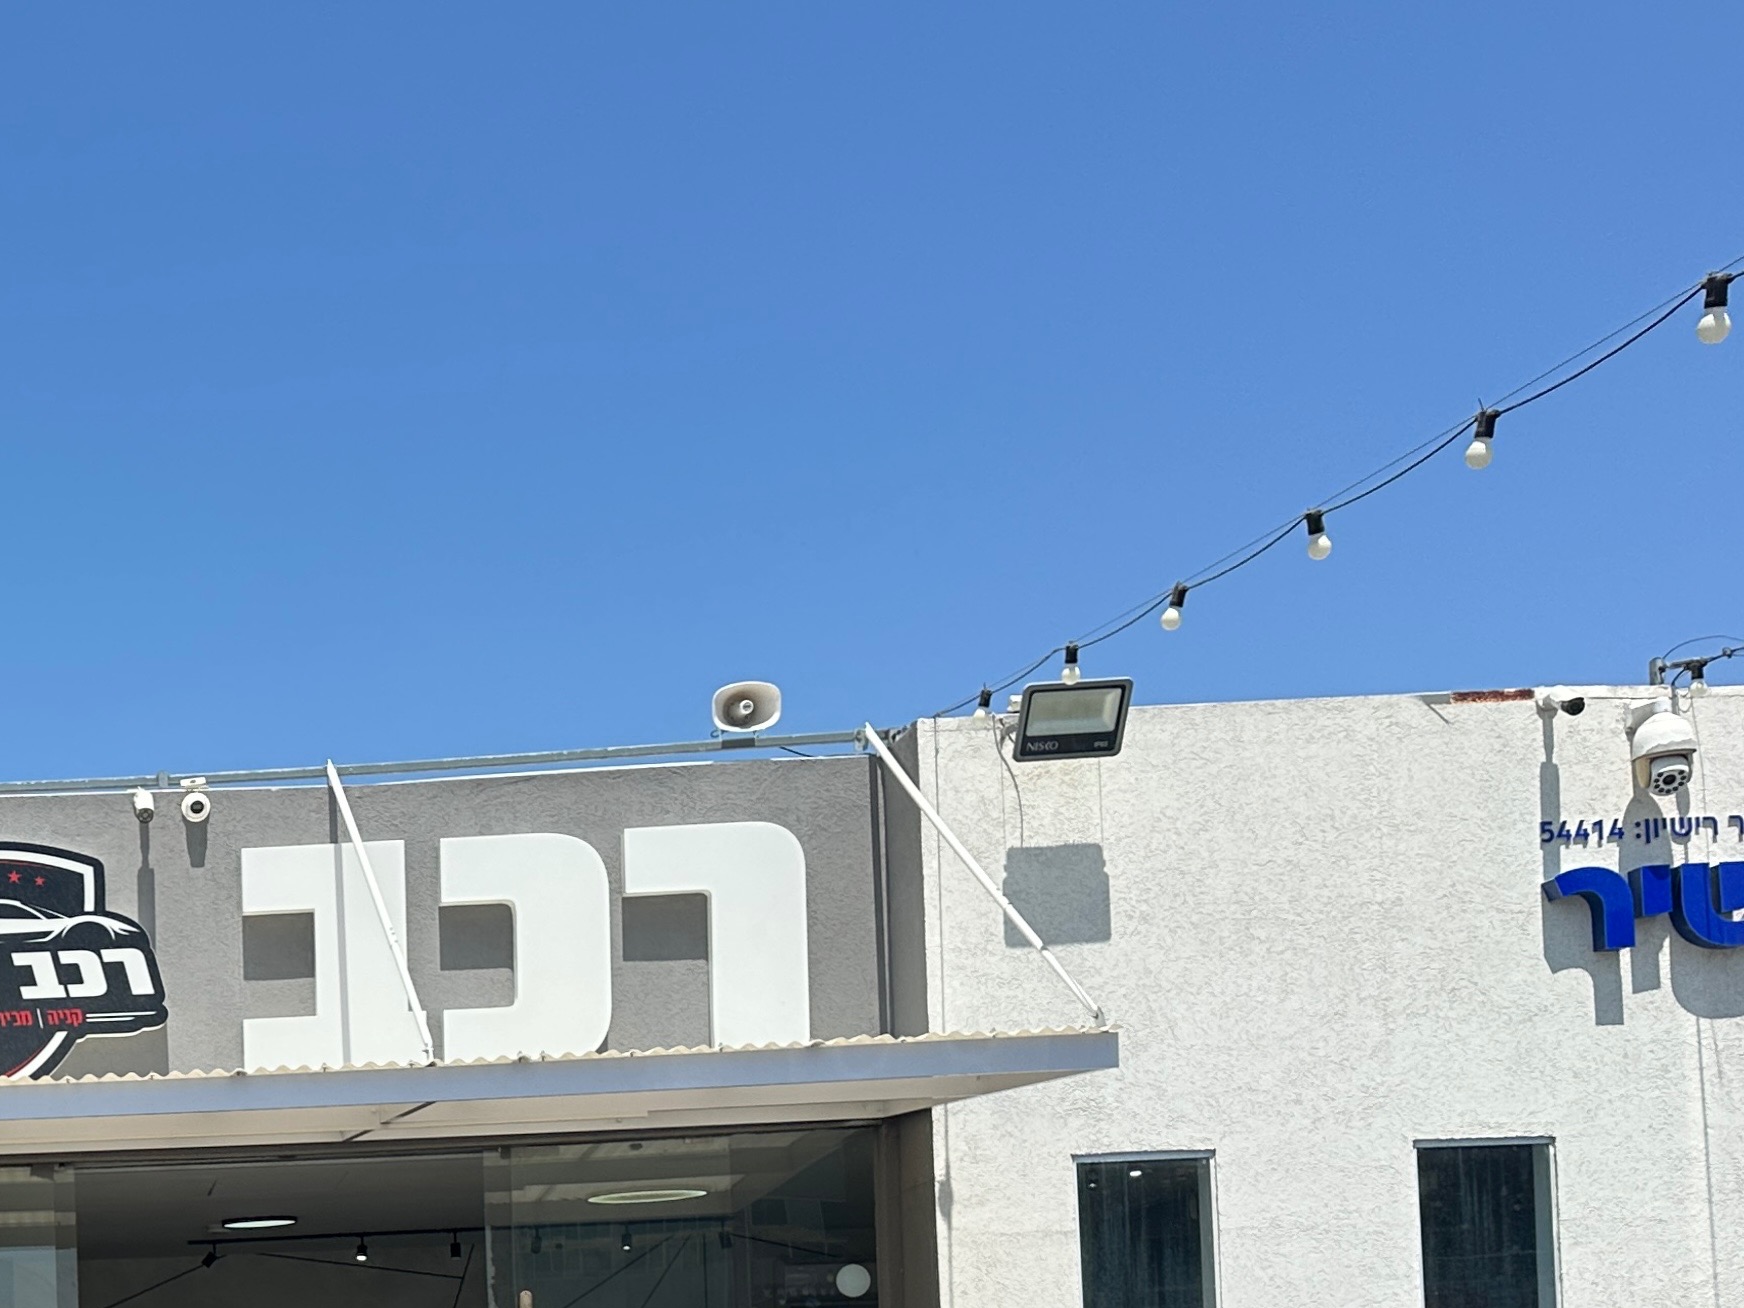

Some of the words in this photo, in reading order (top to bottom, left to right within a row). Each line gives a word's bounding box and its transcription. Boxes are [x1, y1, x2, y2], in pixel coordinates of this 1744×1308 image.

[1540, 818, 1625, 843] 54414
[241, 821, 809, 1070] רכב
[11, 947, 156, 1000] רכב
[46, 1007, 84, 1028] קניה
